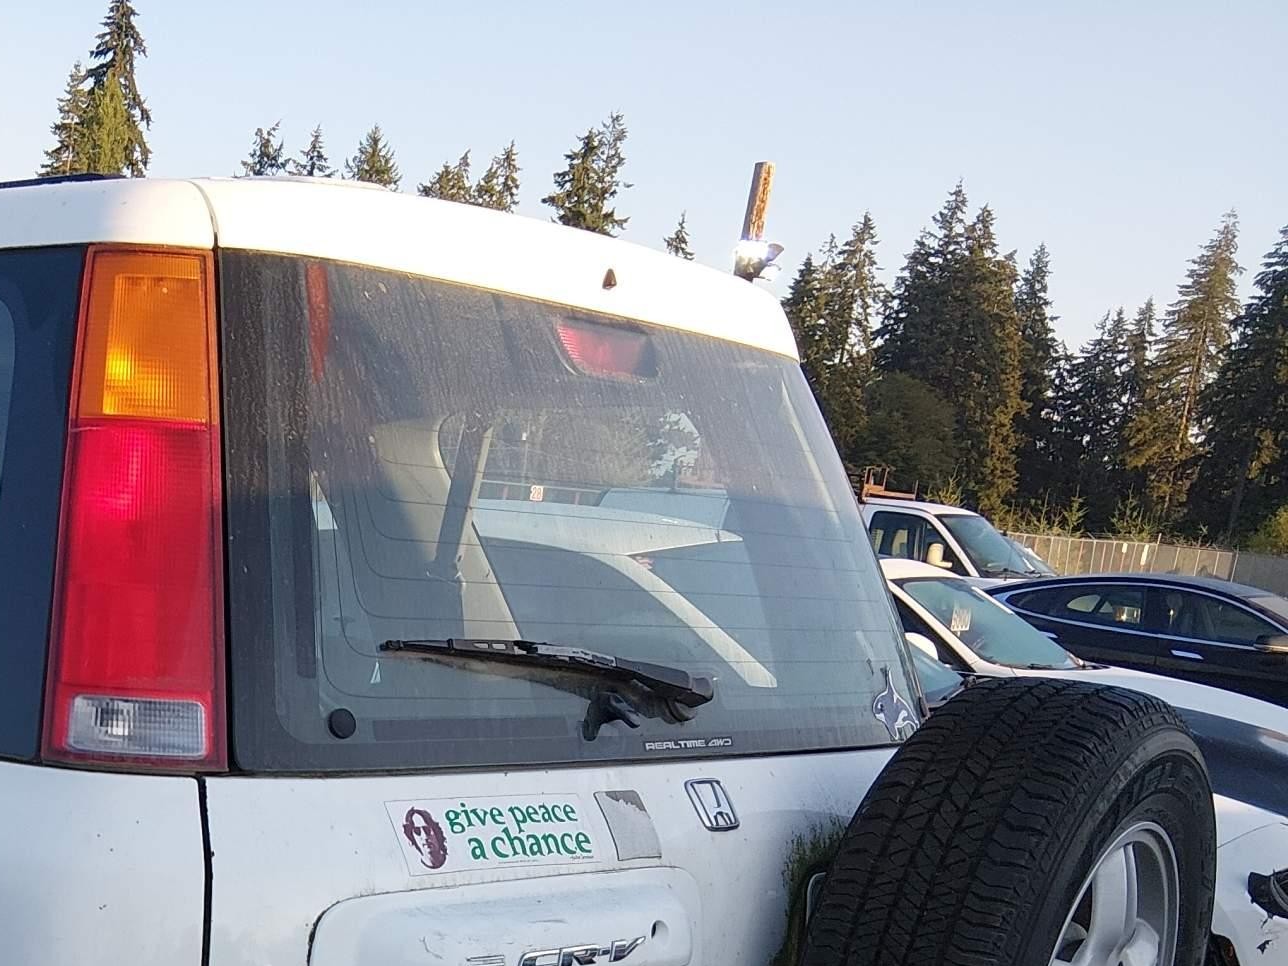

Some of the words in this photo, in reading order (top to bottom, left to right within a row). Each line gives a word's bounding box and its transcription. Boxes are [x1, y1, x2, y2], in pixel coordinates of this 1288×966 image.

[645, 739, 707, 751] REALTIME
[445, 802, 505, 834] give
[508, 802, 578, 833] peace
[468, 837, 489, 861] a
[491, 826, 593, 859] chance
